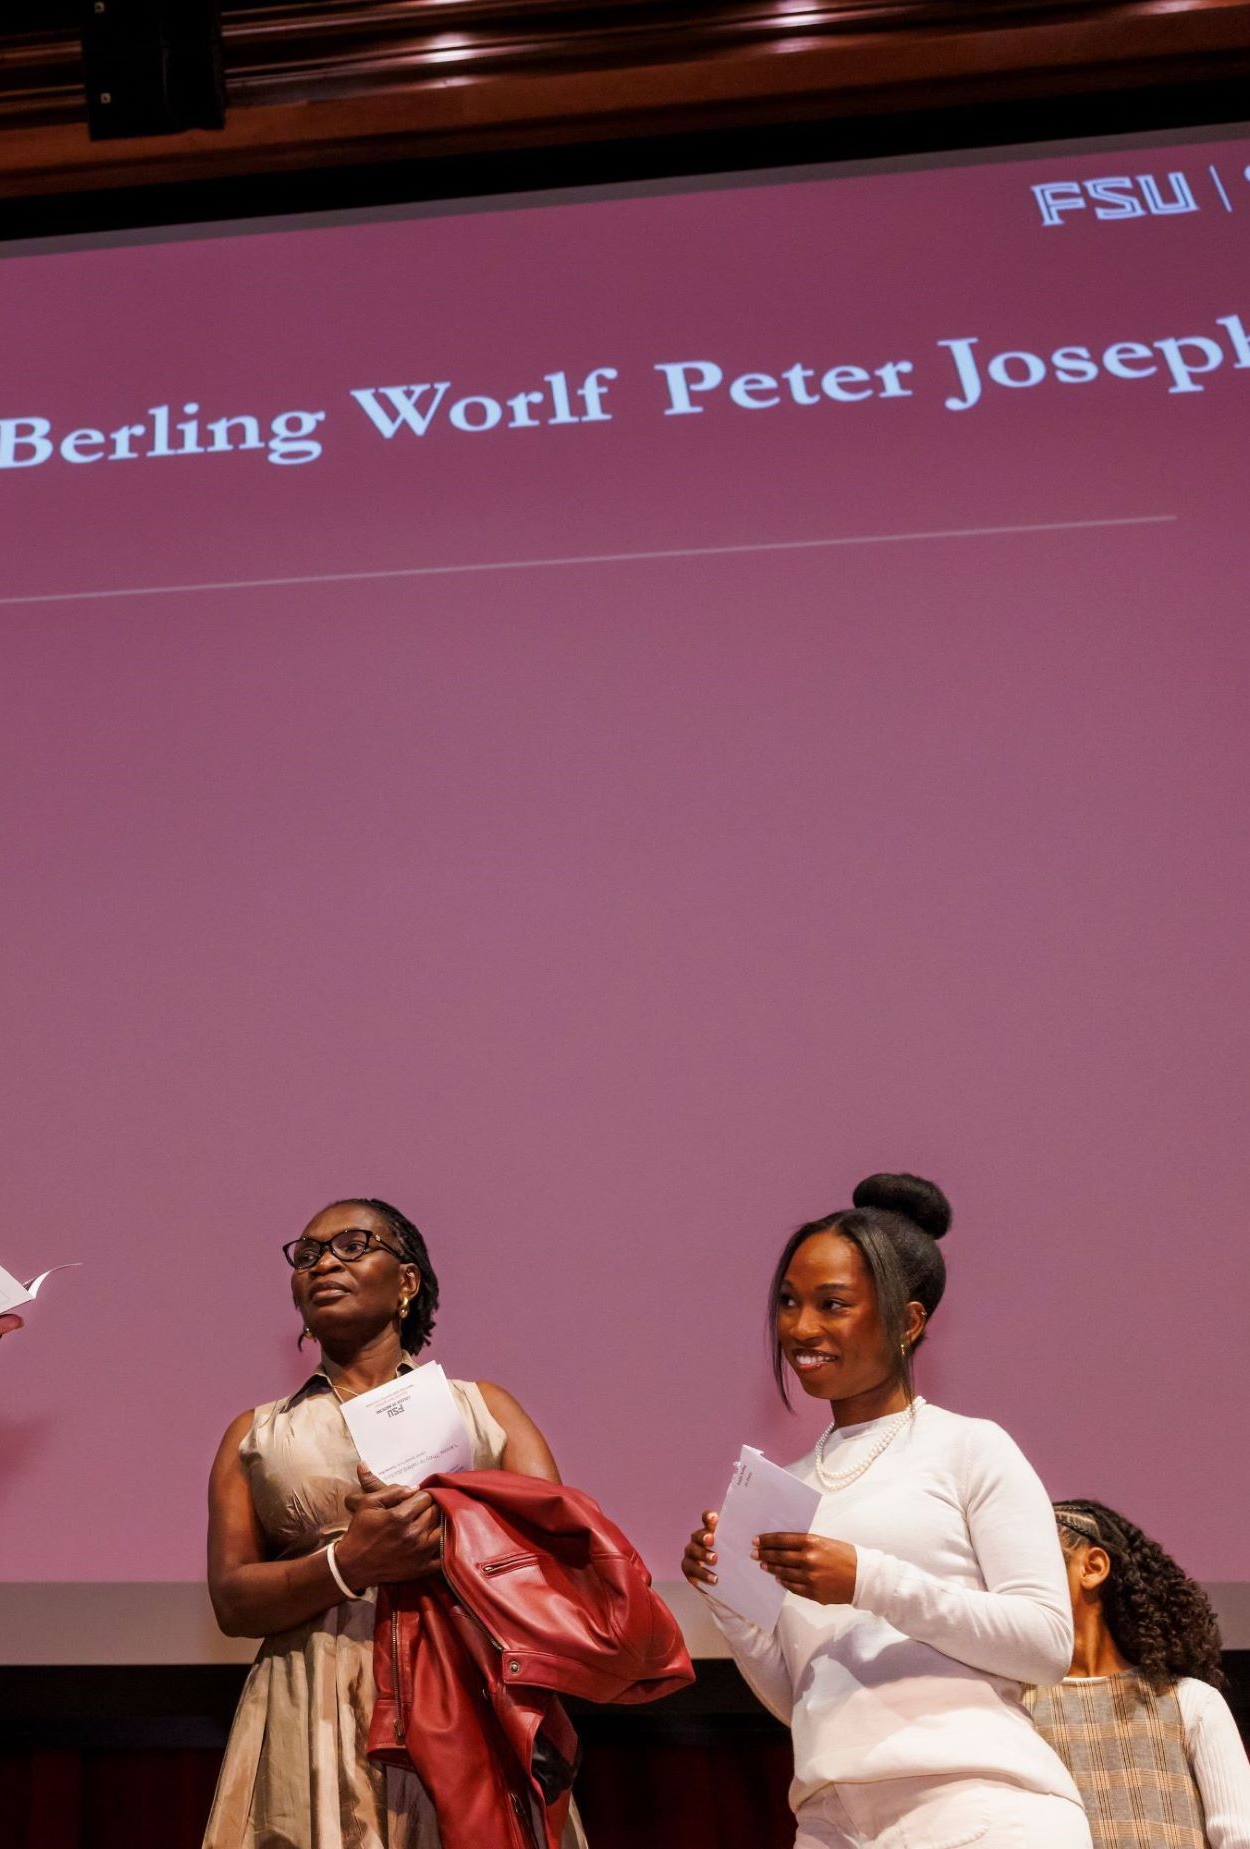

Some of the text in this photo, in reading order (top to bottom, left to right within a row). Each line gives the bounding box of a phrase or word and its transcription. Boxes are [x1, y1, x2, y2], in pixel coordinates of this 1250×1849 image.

[1030, 171, 1199, 226] FSU
[350, 367, 618, 439] Worlf
[653, 360, 914, 415] Peter
